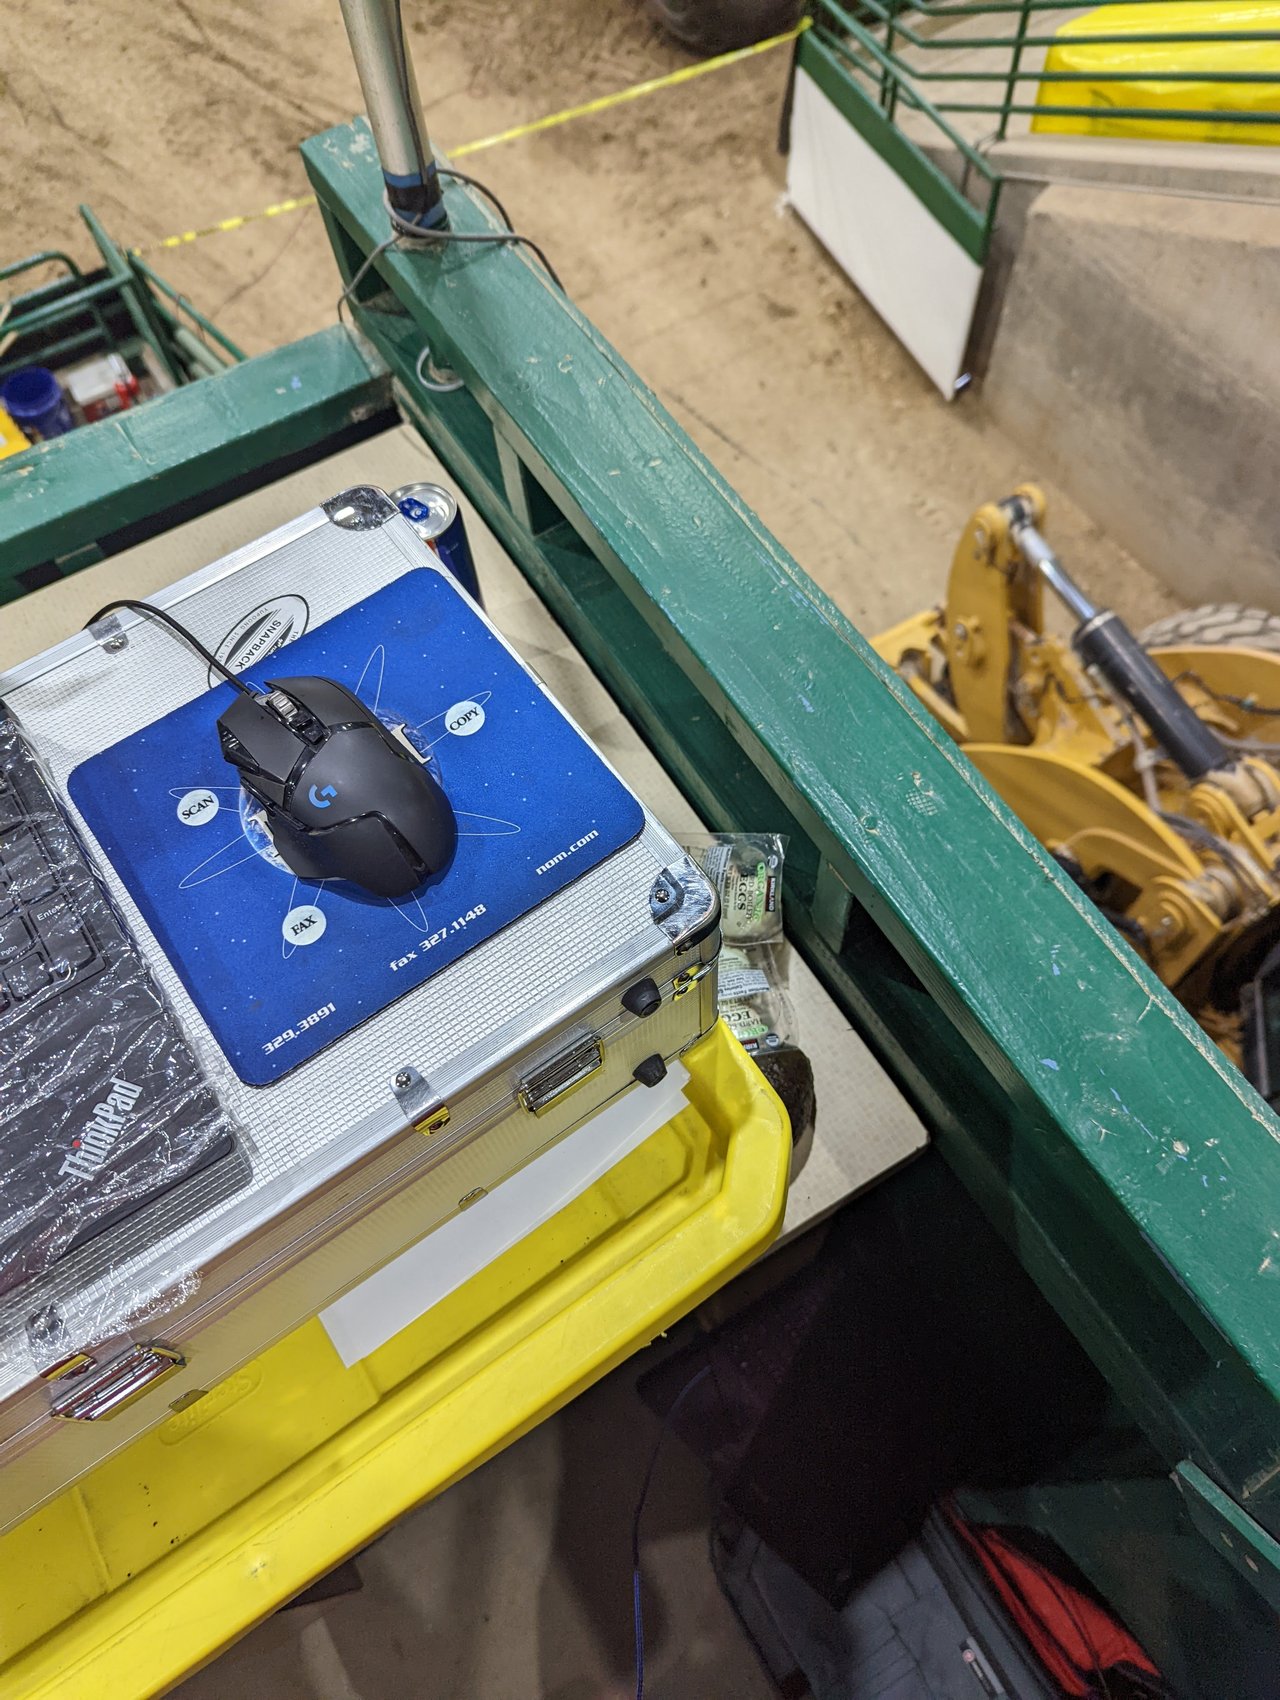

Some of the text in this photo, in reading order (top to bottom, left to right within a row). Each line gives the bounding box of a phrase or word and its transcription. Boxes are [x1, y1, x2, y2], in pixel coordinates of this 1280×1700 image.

[224, 632, 239, 648] SINCE
[235, 619, 282, 669] SNAPBACK
[448, 706, 480, 731] COPY
[181, 794, 216, 821] SCAN
[535, 829, 600, 876] nom.com
[737, 873, 749, 911] EGGS
[752, 861, 766, 923] ORGANIC
[768, 876, 776, 912] KIRKLAND
[36, 904, 62, 921] Enter
[290, 914, 319, 936] FAX
[389, 903, 487, 972] fax 327.1148
[261, 1002, 337, 1055] 329.3891
[57, 1076, 144, 1182] ThinkPad
